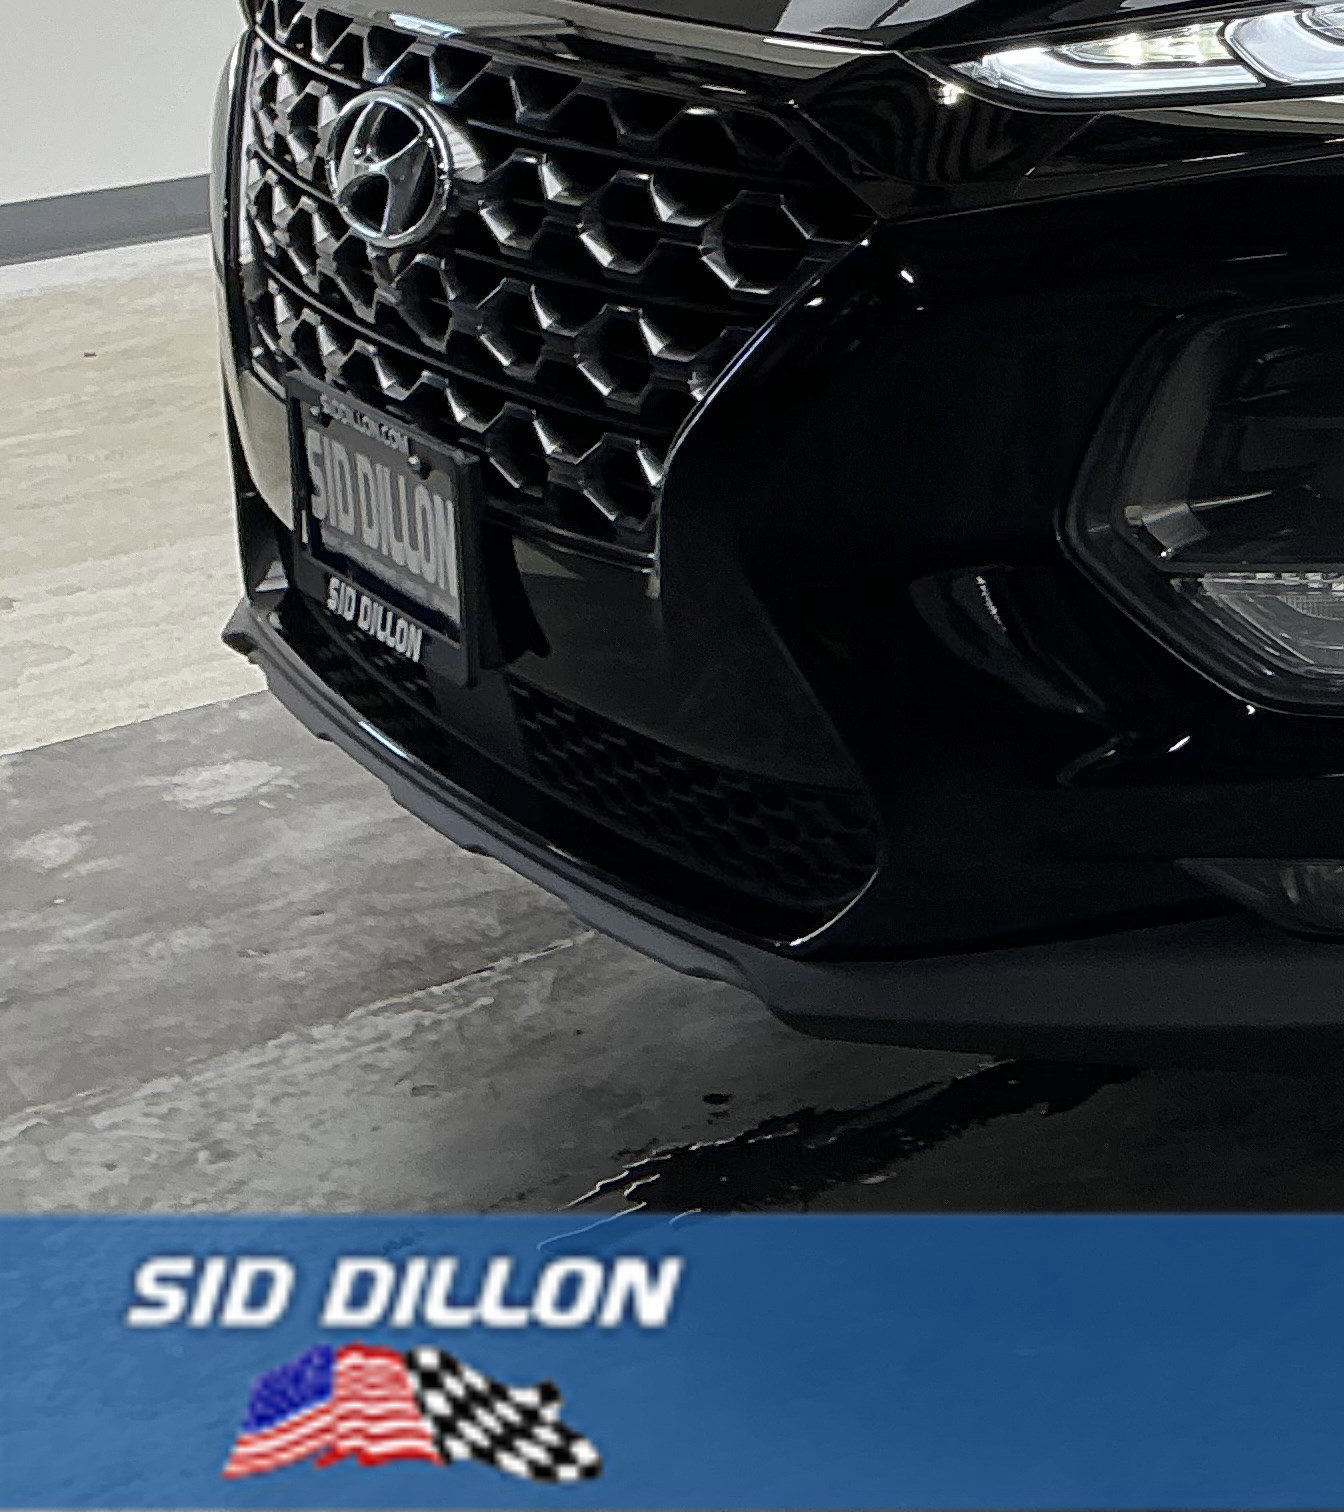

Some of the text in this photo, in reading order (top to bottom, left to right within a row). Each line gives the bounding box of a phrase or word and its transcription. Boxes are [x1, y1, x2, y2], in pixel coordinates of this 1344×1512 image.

[306, 428, 459, 598] SID DILLON
[326, 576, 423, 663] SID DILLON
